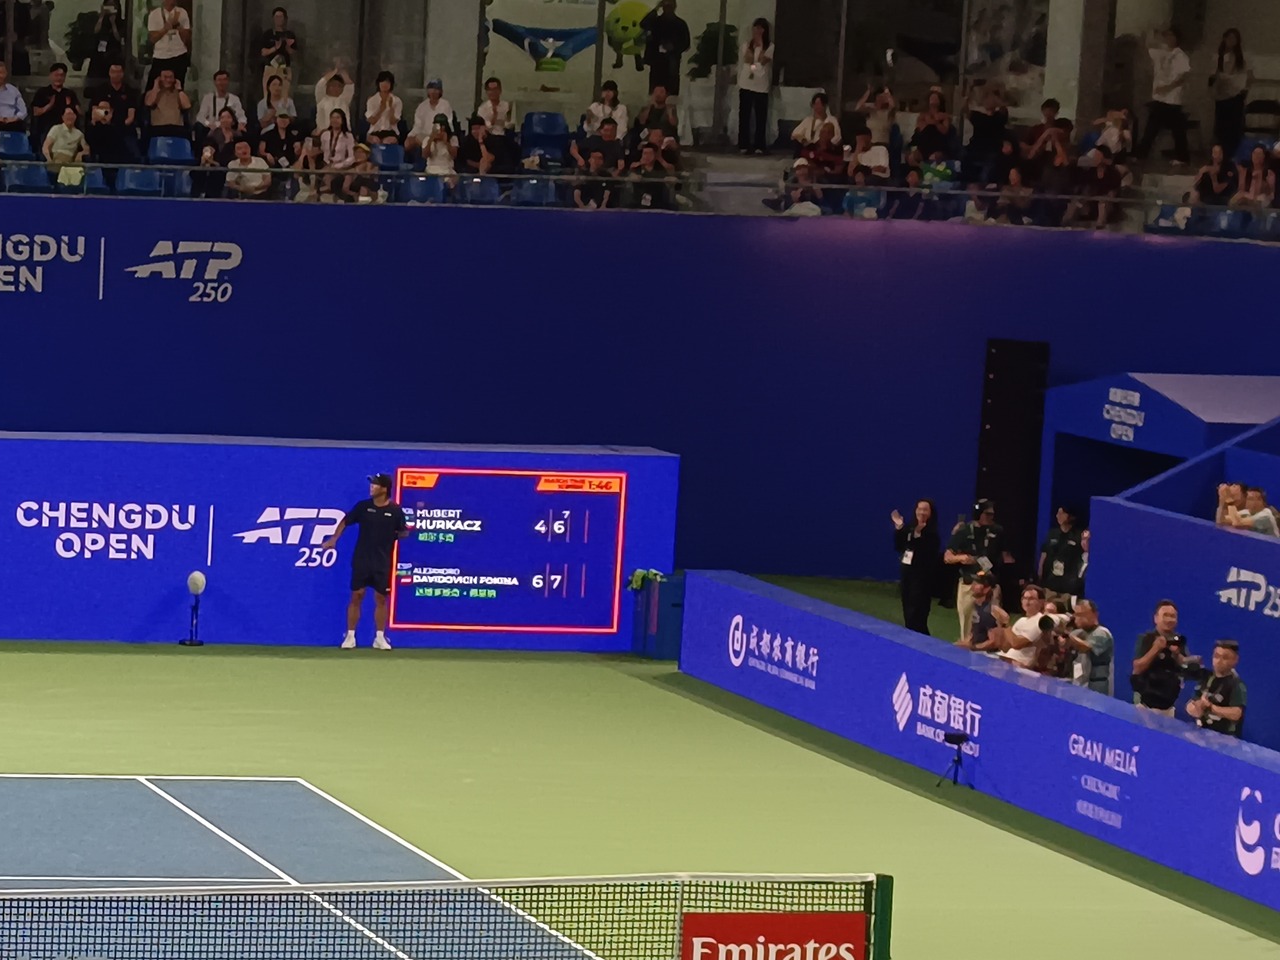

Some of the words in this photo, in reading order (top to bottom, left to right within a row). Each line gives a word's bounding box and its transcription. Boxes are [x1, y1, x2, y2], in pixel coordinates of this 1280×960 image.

[124, 240, 243, 280] ATP
[188, 282, 233, 303] 250
[16, 501, 196, 531] CHENGDU
[232, 507, 346, 545] ATP
[416, 519, 482, 531] HURKACZ
[534, 520, 547, 533] 4
[553, 520, 565, 534] 6
[562, 510, 570, 518] 7
[55, 532, 155, 560] OPEN
[294, 547, 337, 567] 250
[532, 575, 543, 588] 6
[550, 575, 562, 589] 7
[1216, 566, 1267, 611] ATP
[917, 684, 982, 737] 成都银行
[1068, 733, 1103, 763] GRAN
